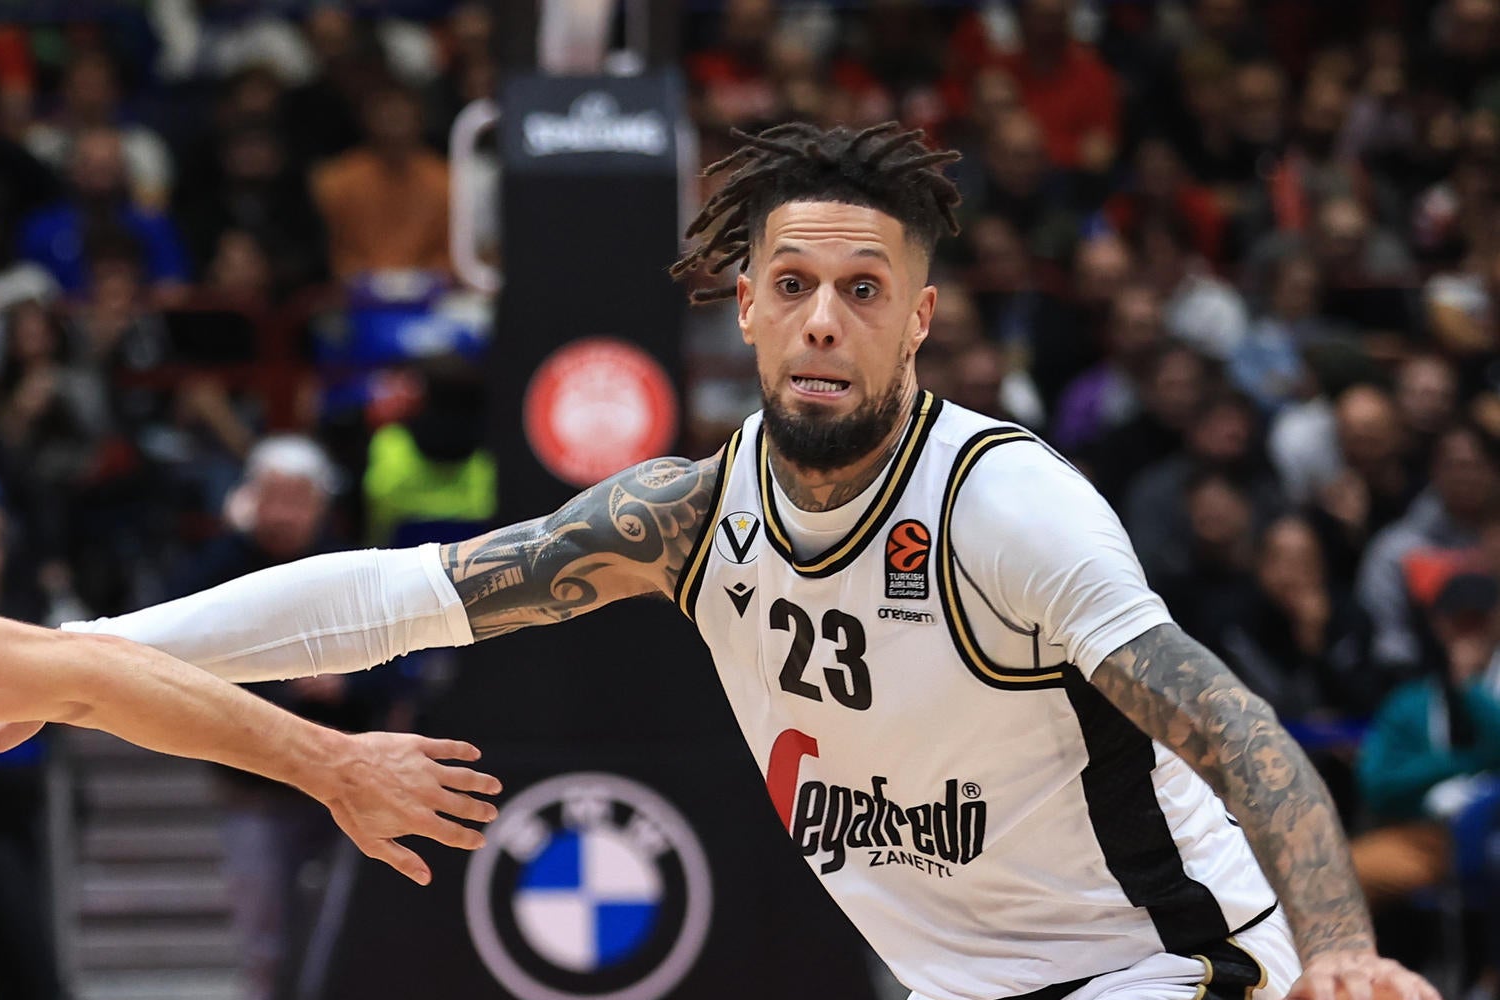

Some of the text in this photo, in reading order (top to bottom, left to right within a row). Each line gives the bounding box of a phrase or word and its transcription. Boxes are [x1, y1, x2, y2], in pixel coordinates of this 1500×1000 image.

[889, 573, 924, 581] TURKISH
[889, 581, 925, 589] AIRLINES
[878, 608, 935, 623] oneteam
[768, 598, 872, 711] 23
